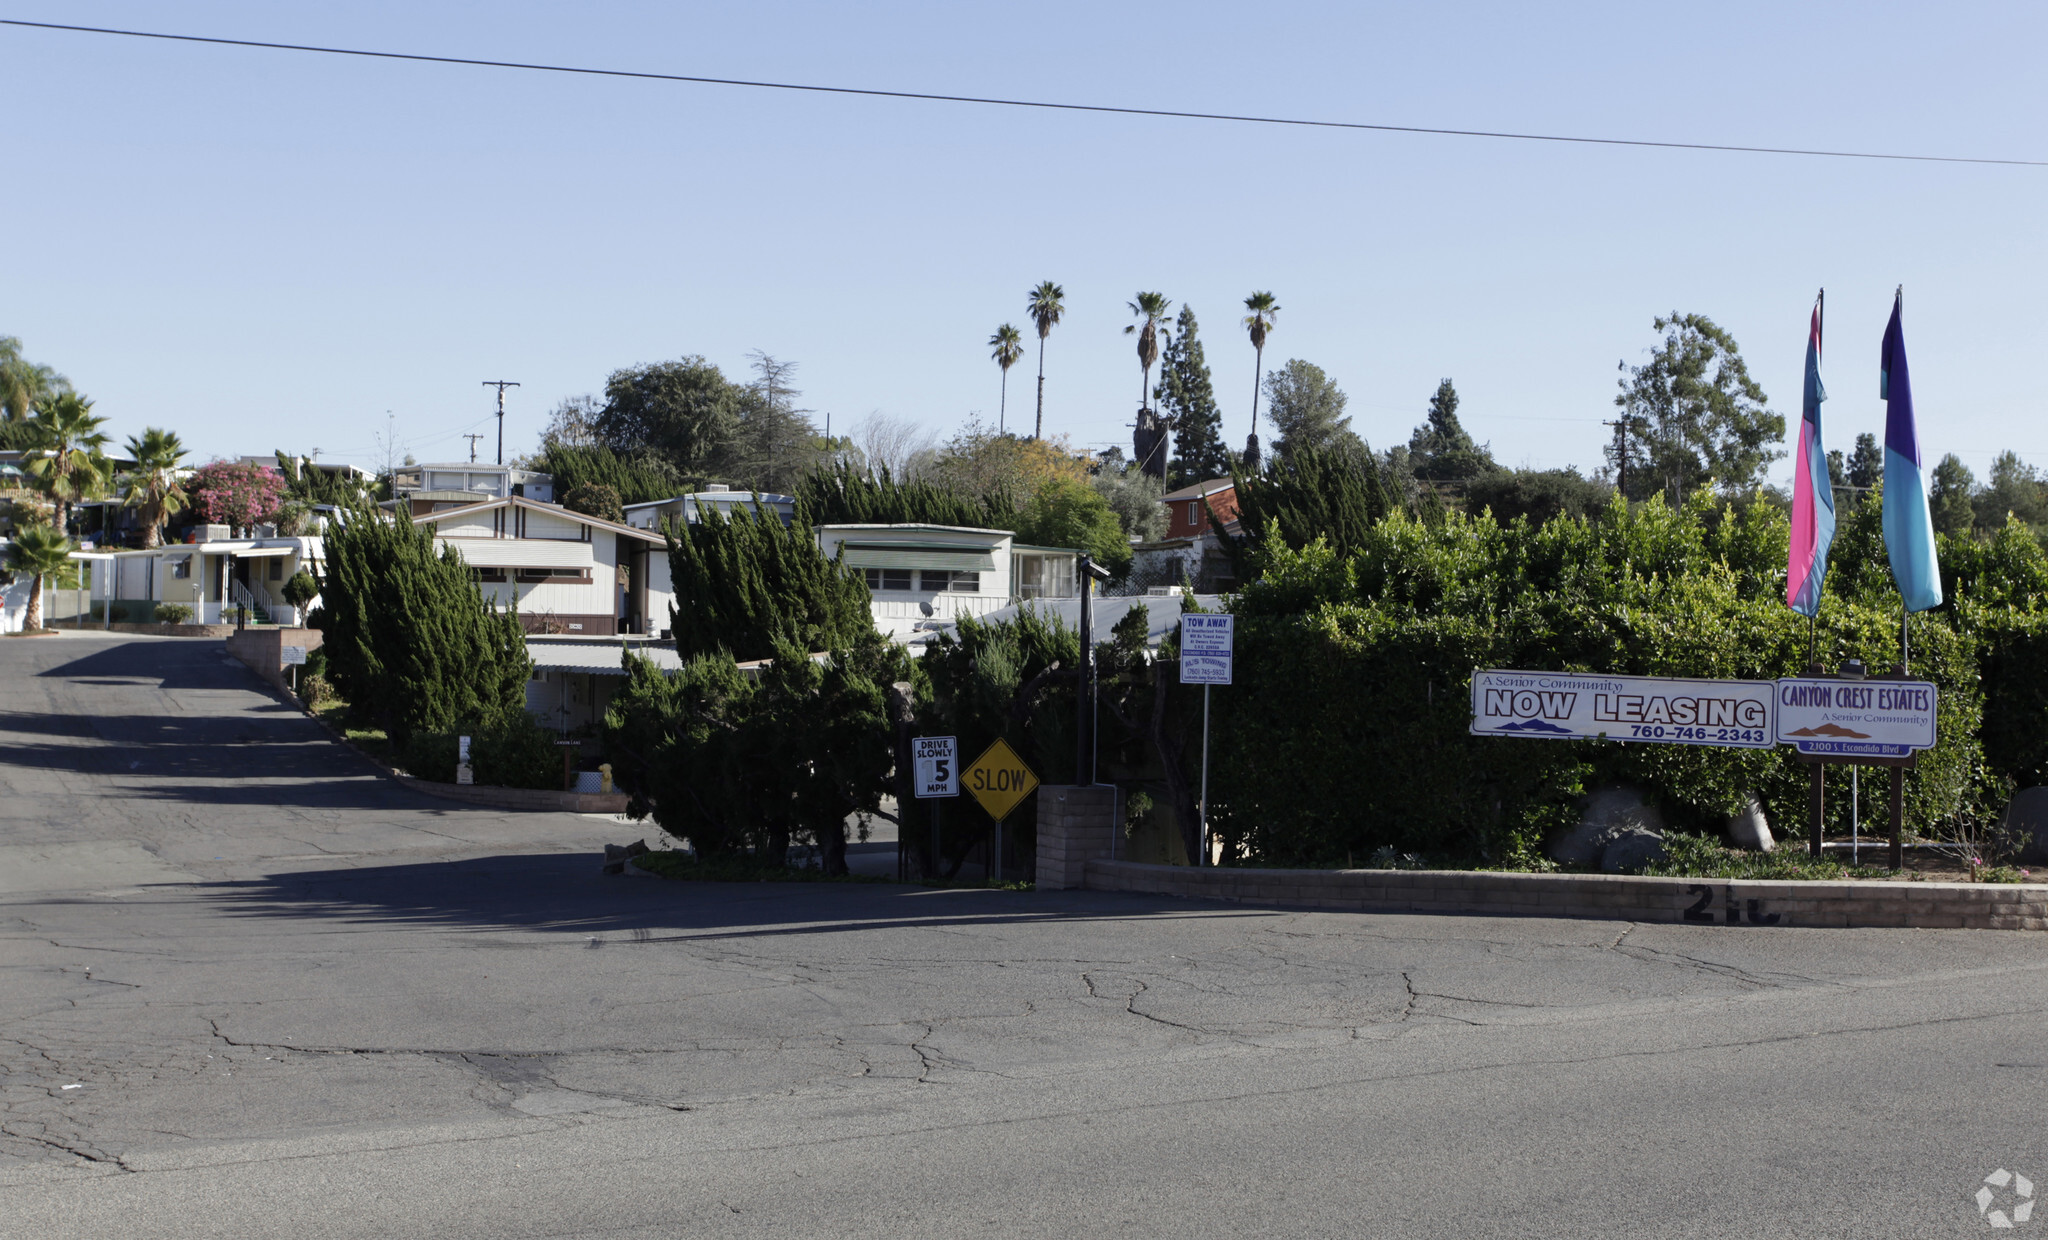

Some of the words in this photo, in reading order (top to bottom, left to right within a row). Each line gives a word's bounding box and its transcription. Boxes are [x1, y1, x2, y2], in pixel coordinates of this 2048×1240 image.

[1188, 618, 1204, 627] TOW
[1207, 618, 1228, 628] AWAY
[1185, 659, 1200, 668] AL'S
[1200, 658, 1228, 669] TOWING
[1482, 676, 1493, 686] A
[1495, 675, 1537, 688] Senior
[1538, 678, 1624, 694] Community
[1781, 686, 1832, 708] CANYON
[1836, 687, 1874, 709] CREST
[1878, 688, 1930, 712] ESTATES
[1485, 688, 1577, 720] NOW
[1594, 693, 1766, 729] LEASING
[1822, 713, 1830, 721] A
[1832, 712, 1862, 722] Senior
[1864, 714, 1928, 726] Community
[1631, 724, 1765, 742] 760-746-2343
[921, 740, 949, 750] DRIVE
[1809, 742, 1832, 752] 2100
[1842, 743, 1880, 753] Escondido
[917, 748, 952, 758] SLOWLY
[973, 768, 1026, 792] SLOW
[927, 784, 948, 793] MPH
